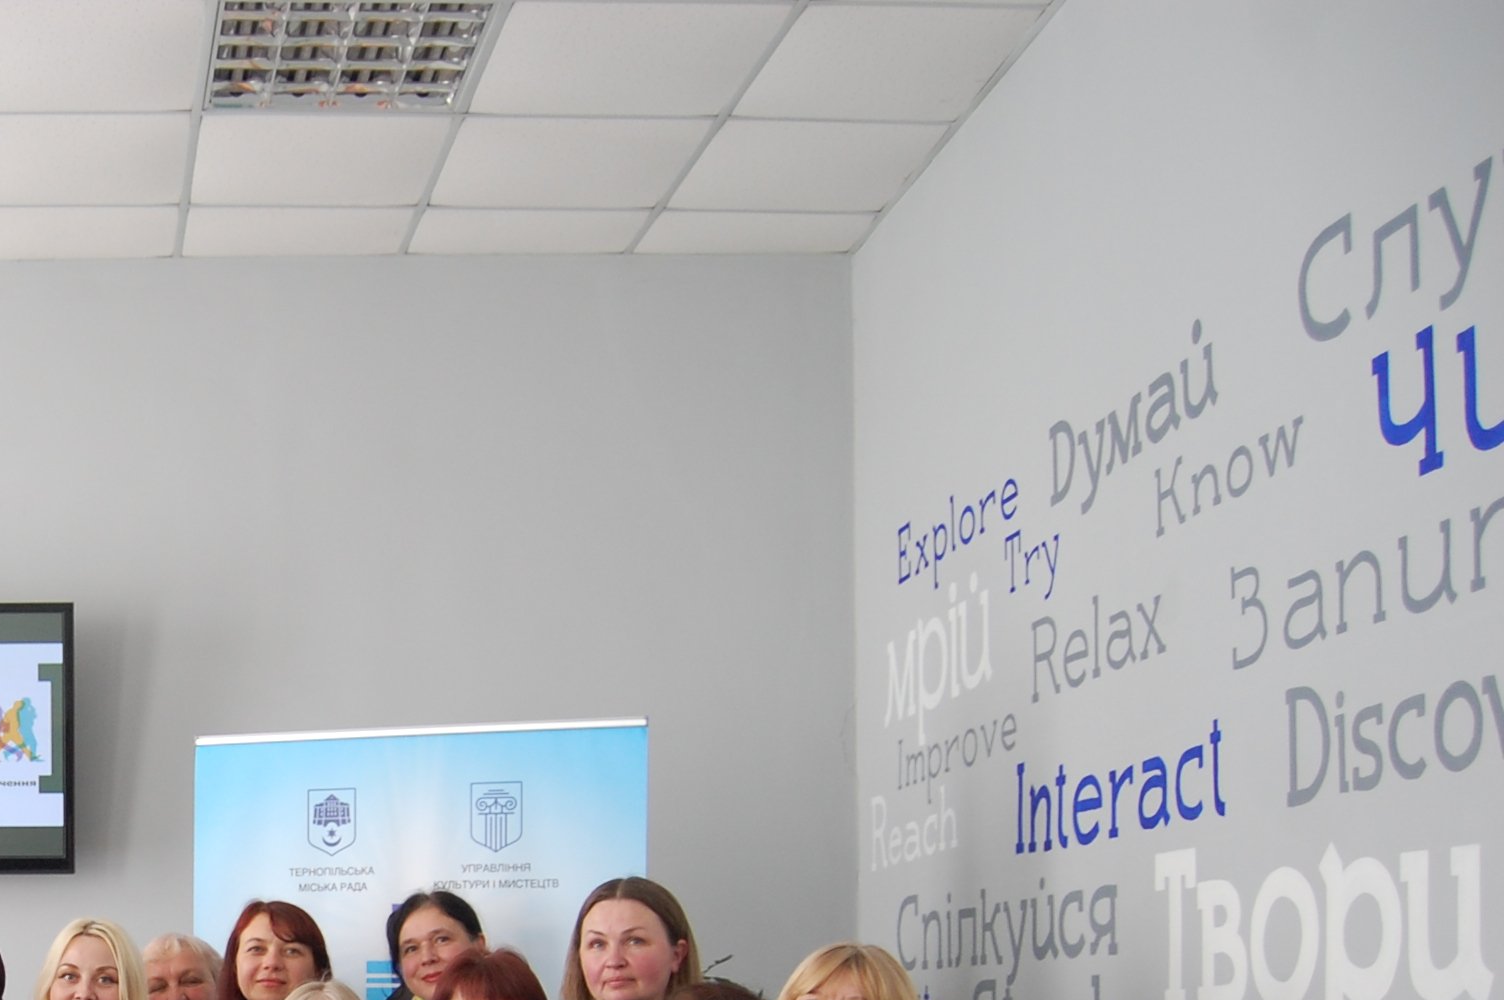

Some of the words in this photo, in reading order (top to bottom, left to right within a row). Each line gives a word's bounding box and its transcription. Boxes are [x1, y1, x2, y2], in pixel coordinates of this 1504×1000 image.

[1298, 149, 1504, 342] Слу
[1154, 415, 1303, 538] Know
[897, 478, 1019, 590] Explore
[1004, 530, 1060, 600] Try
[1030, 594, 1167, 703] Relax
[897, 713, 1017, 804] Improve
[1015, 719, 1226, 855] Interact
[289, 866, 375, 877] ТЕРНОПІЛЬСЬКА
[461, 862, 531, 873] УПРАВЛІННЯ
[871, 785, 958, 872] Reach
[298, 882, 337, 892] МІСЬКА
[340, 882, 368, 892] РАДА
[433, 880, 490, 890] КУЛЬТУРИ
[498, 878, 560, 889] МИСТЕЦТВ
[897, 877, 1118, 986] Спілкуйся
